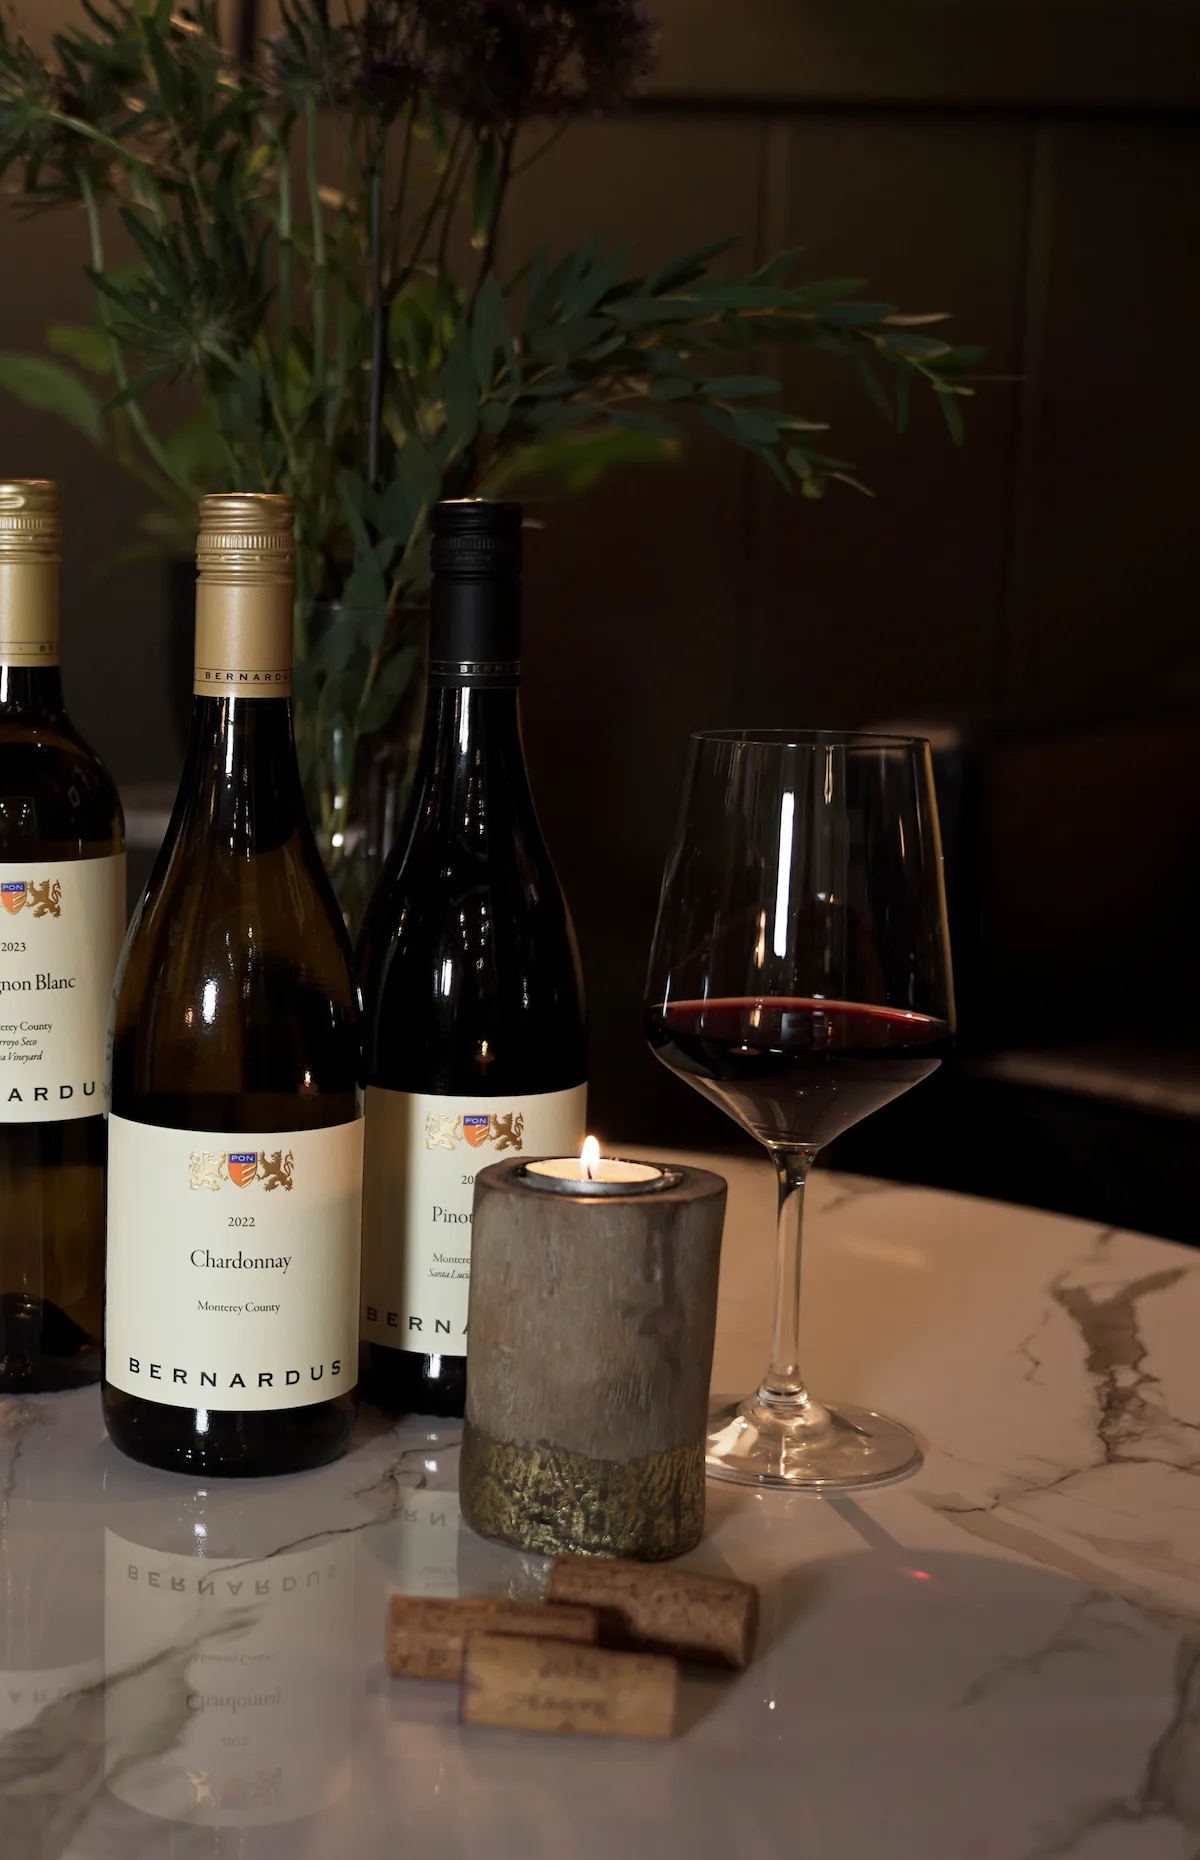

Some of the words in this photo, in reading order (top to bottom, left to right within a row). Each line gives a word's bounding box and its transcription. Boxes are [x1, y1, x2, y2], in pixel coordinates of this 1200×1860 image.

[1, 942, 26, 952] 2023
[35, 973, 76, 991] Blanc
[19, 1021, 53, 1033] County
[20, 1037, 37, 1047] Seco
[7, 1051, 43, 1064] Vineyard
[461, 1175, 476, 1184] 20
[432, 1206, 473, 1224] Pinot
[228, 1217, 255, 1227] 2022
[190, 1249, 292, 1274] Chardonnay
[428, 1268, 450, 1279] Santa
[197, 1300, 244, 1315] Monterey
[245, 1302, 280, 1313] County
[129, 1357, 341, 1388] BERNARDUS
